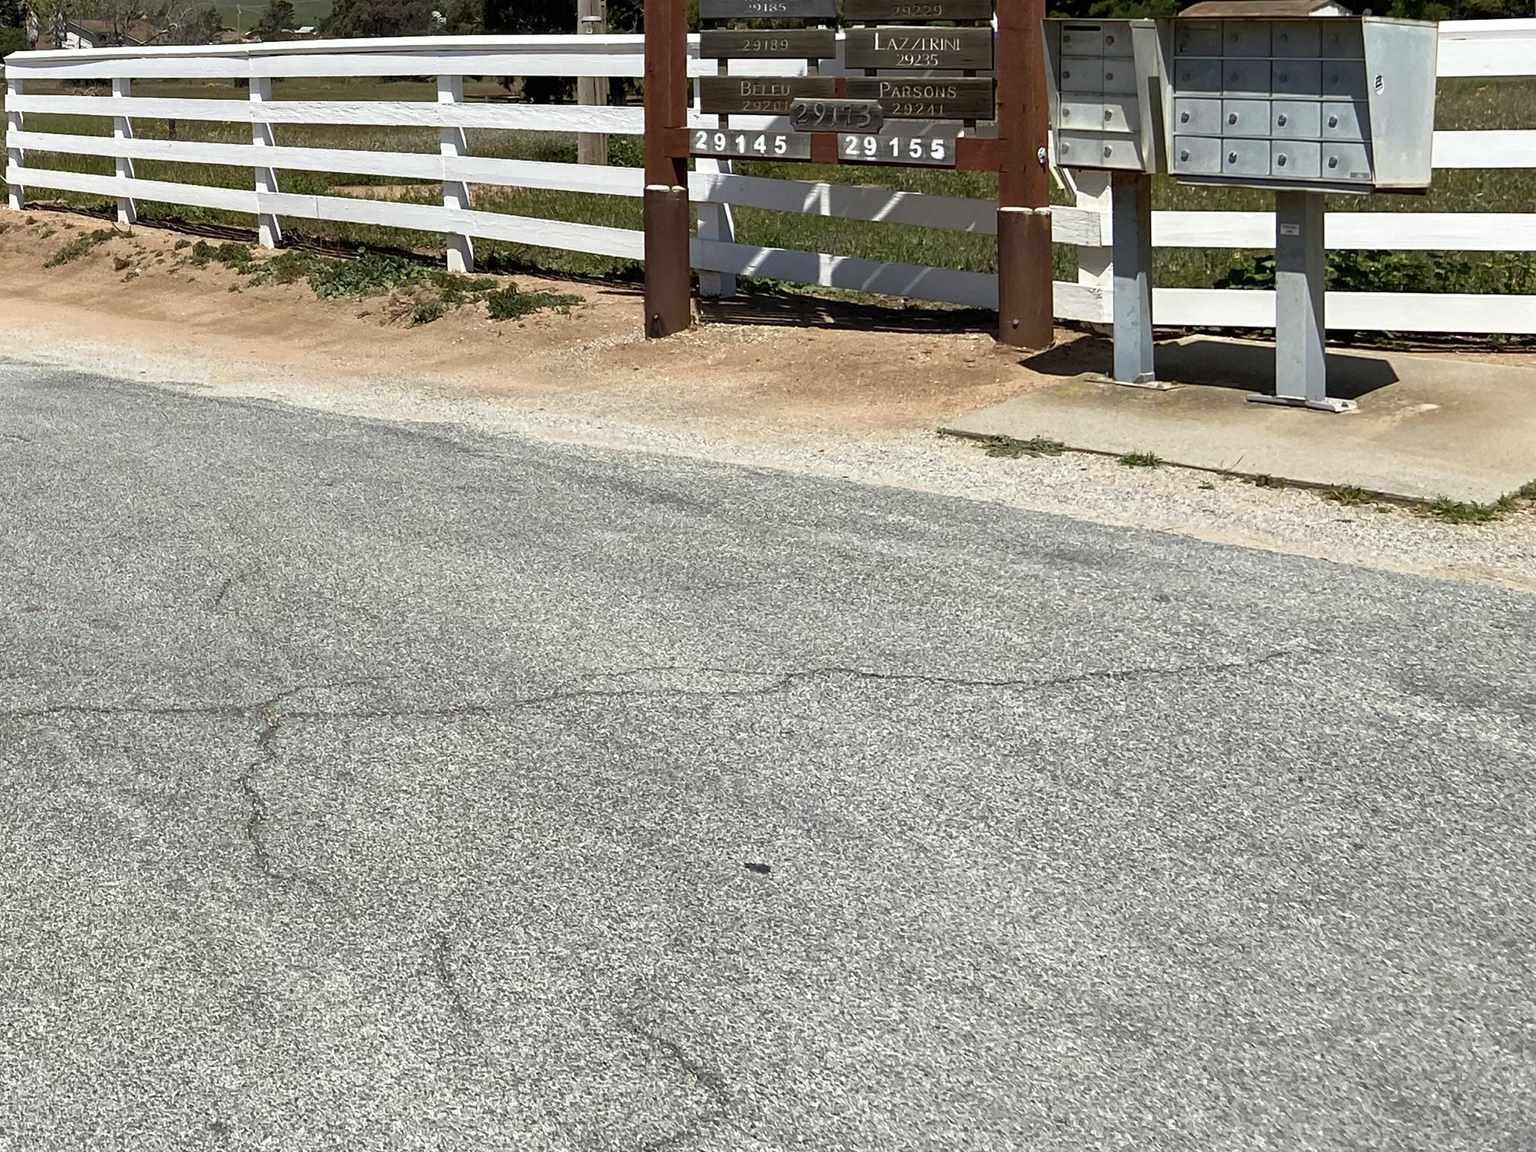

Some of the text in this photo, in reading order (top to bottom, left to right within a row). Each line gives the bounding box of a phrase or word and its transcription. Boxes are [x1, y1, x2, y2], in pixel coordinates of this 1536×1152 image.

[743, 39, 789, 52] 29189
[874, 32, 960, 51] LAZZERINI
[896, 53, 939, 66] 29235
[879, 81, 957, 98] PARSONS
[796, 102, 872, 128] 29173
[695, 131, 787, 155] 29145
[845, 136, 945, 160] 29155
